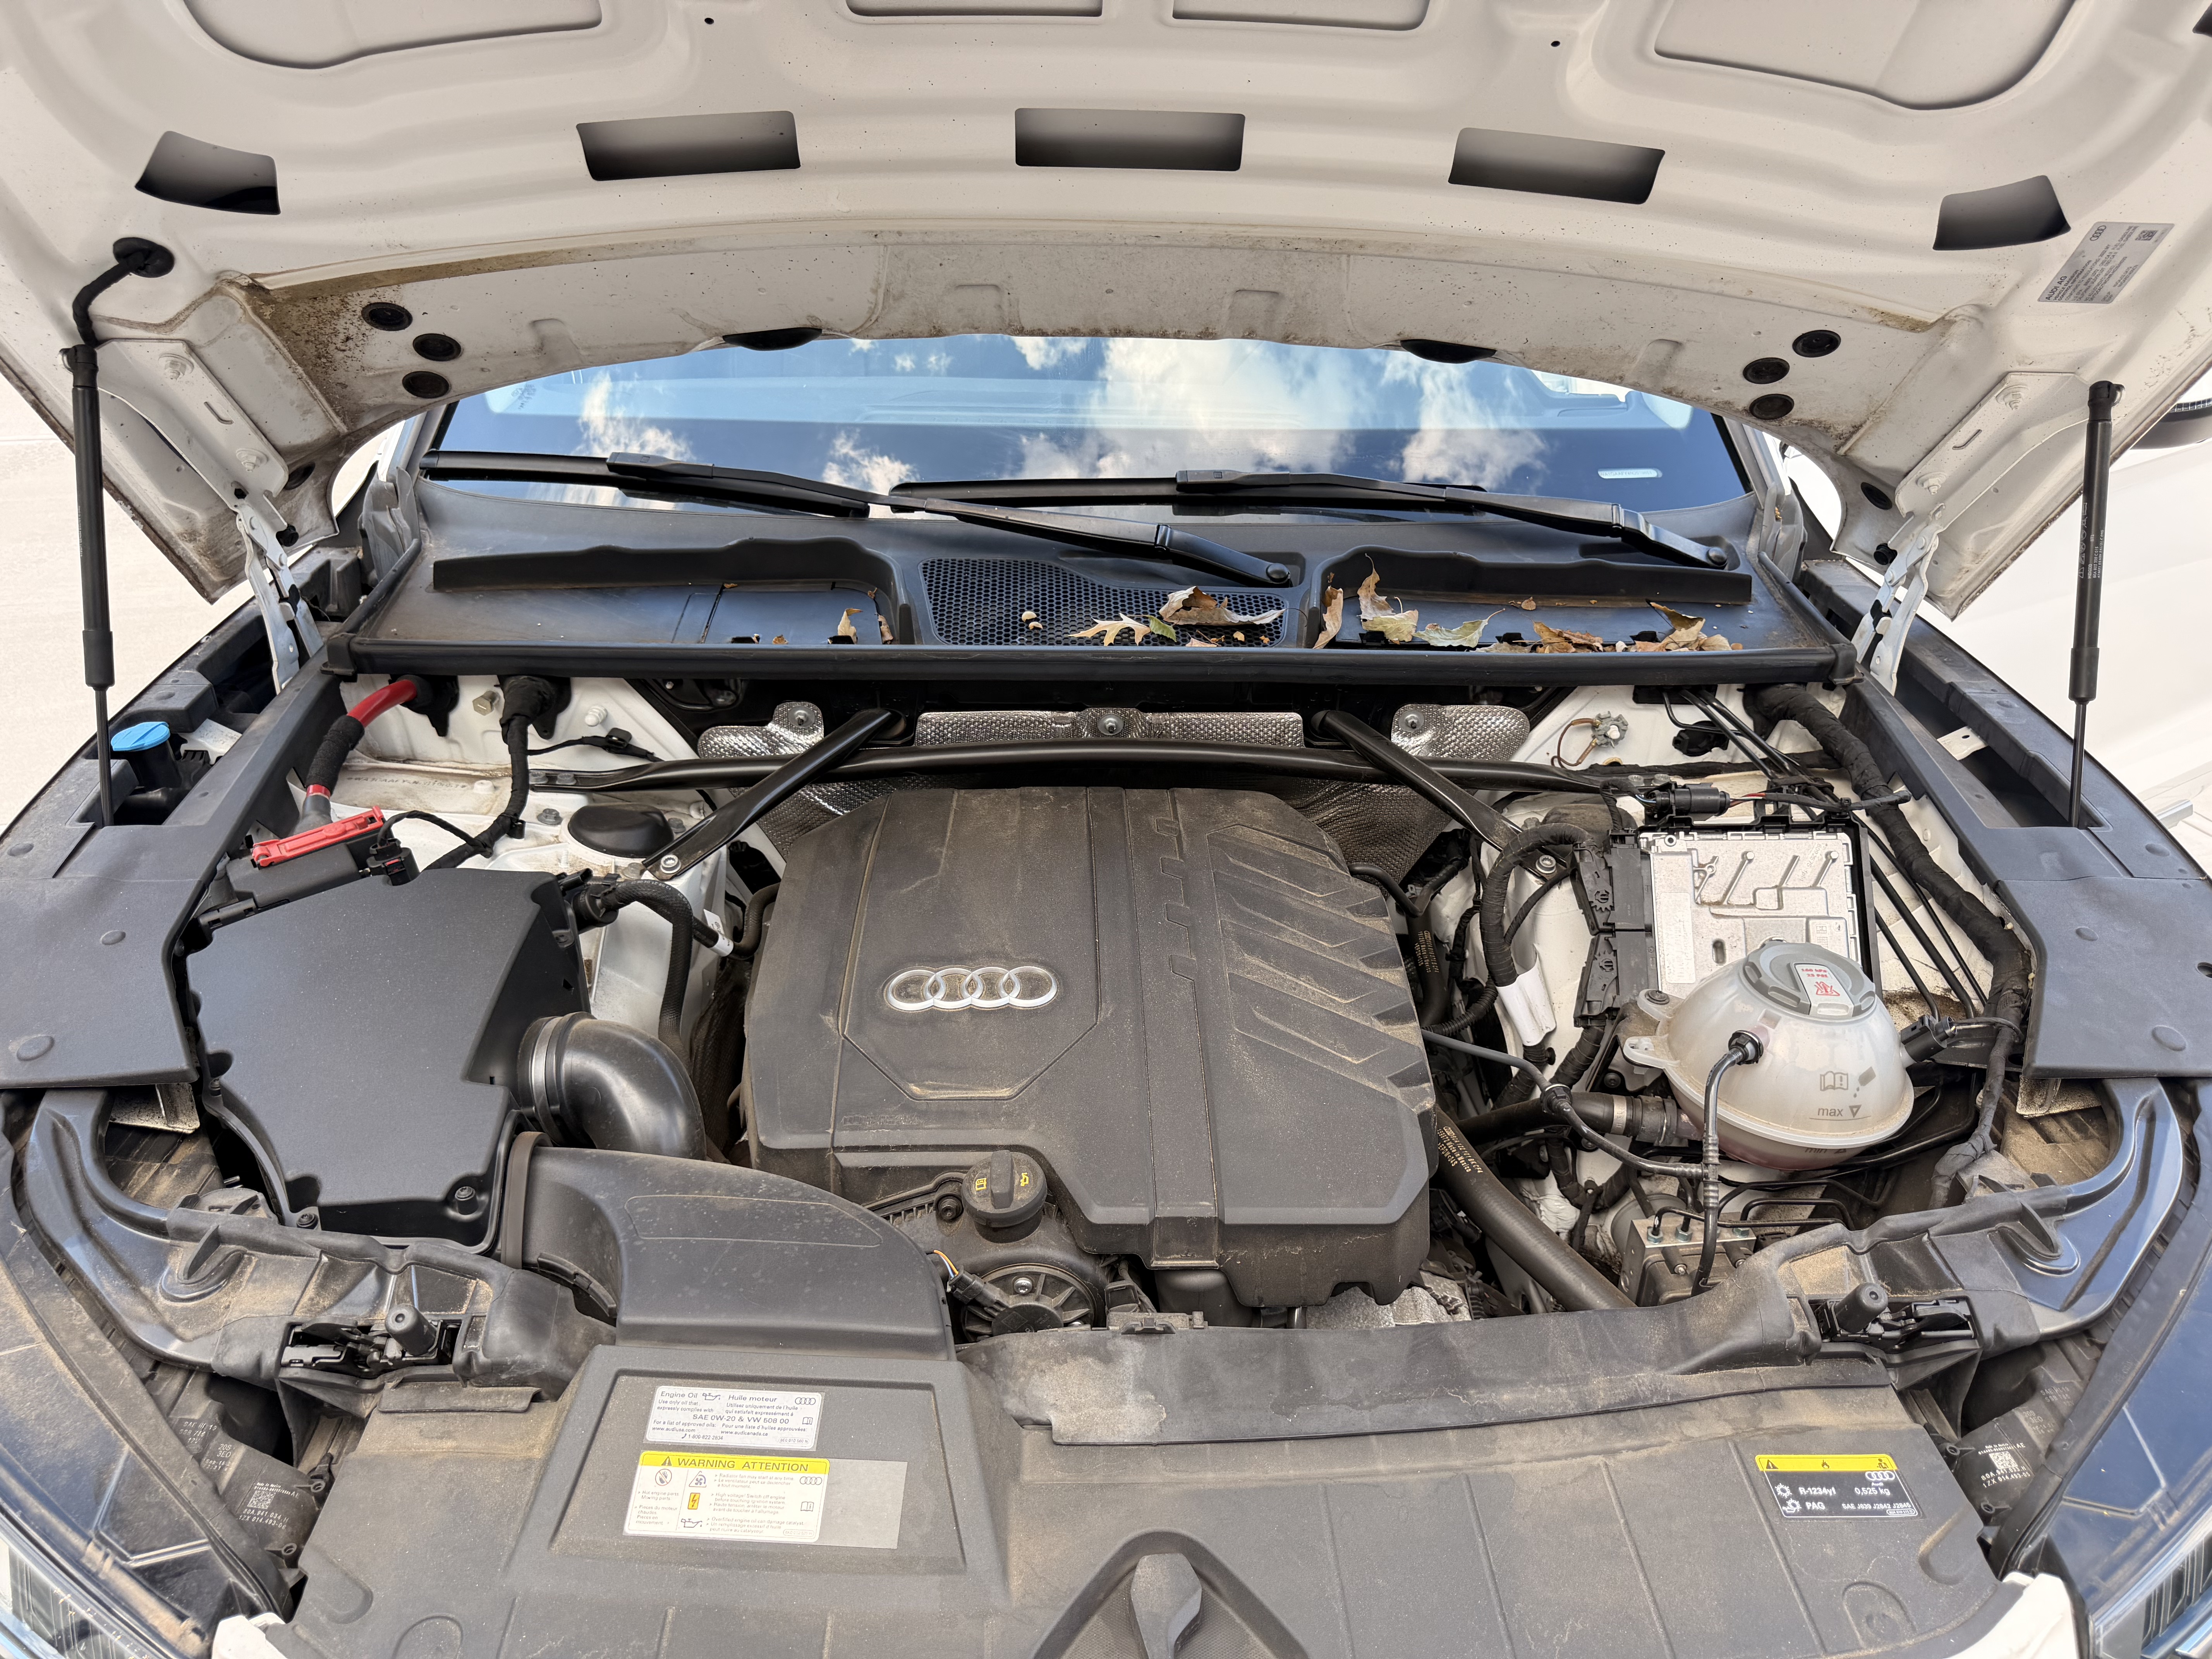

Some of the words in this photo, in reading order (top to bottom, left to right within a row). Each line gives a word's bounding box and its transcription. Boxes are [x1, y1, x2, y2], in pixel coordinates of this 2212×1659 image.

[2045, 286, 2059, 300] AUDI
[2057, 275, 2067, 285] AG
[1818, 1106, 1844, 1118] max
[1446, 1141, 1456, 1152] Made
[1457, 1156, 1472, 1172] Mexico
[678, 1458, 735, 1468] WARNING
[743, 1461, 809, 1472] ATTENTION
[1981, 1466, 2026, 1480] 80A.941.033.H
[1983, 1479, 1997, 1488] 1ZX
[1998, 1472, 2030, 1482] 014.493-05
[1799, 1487, 1836, 1496] R-1234yf
[1854, 1487, 1877, 1496] 0,525
[1879, 1487, 1891, 1496] kg
[243, 1509, 289, 1523] 80A.941.034.H
[252, 1516, 286, 1529] 014.493-06
